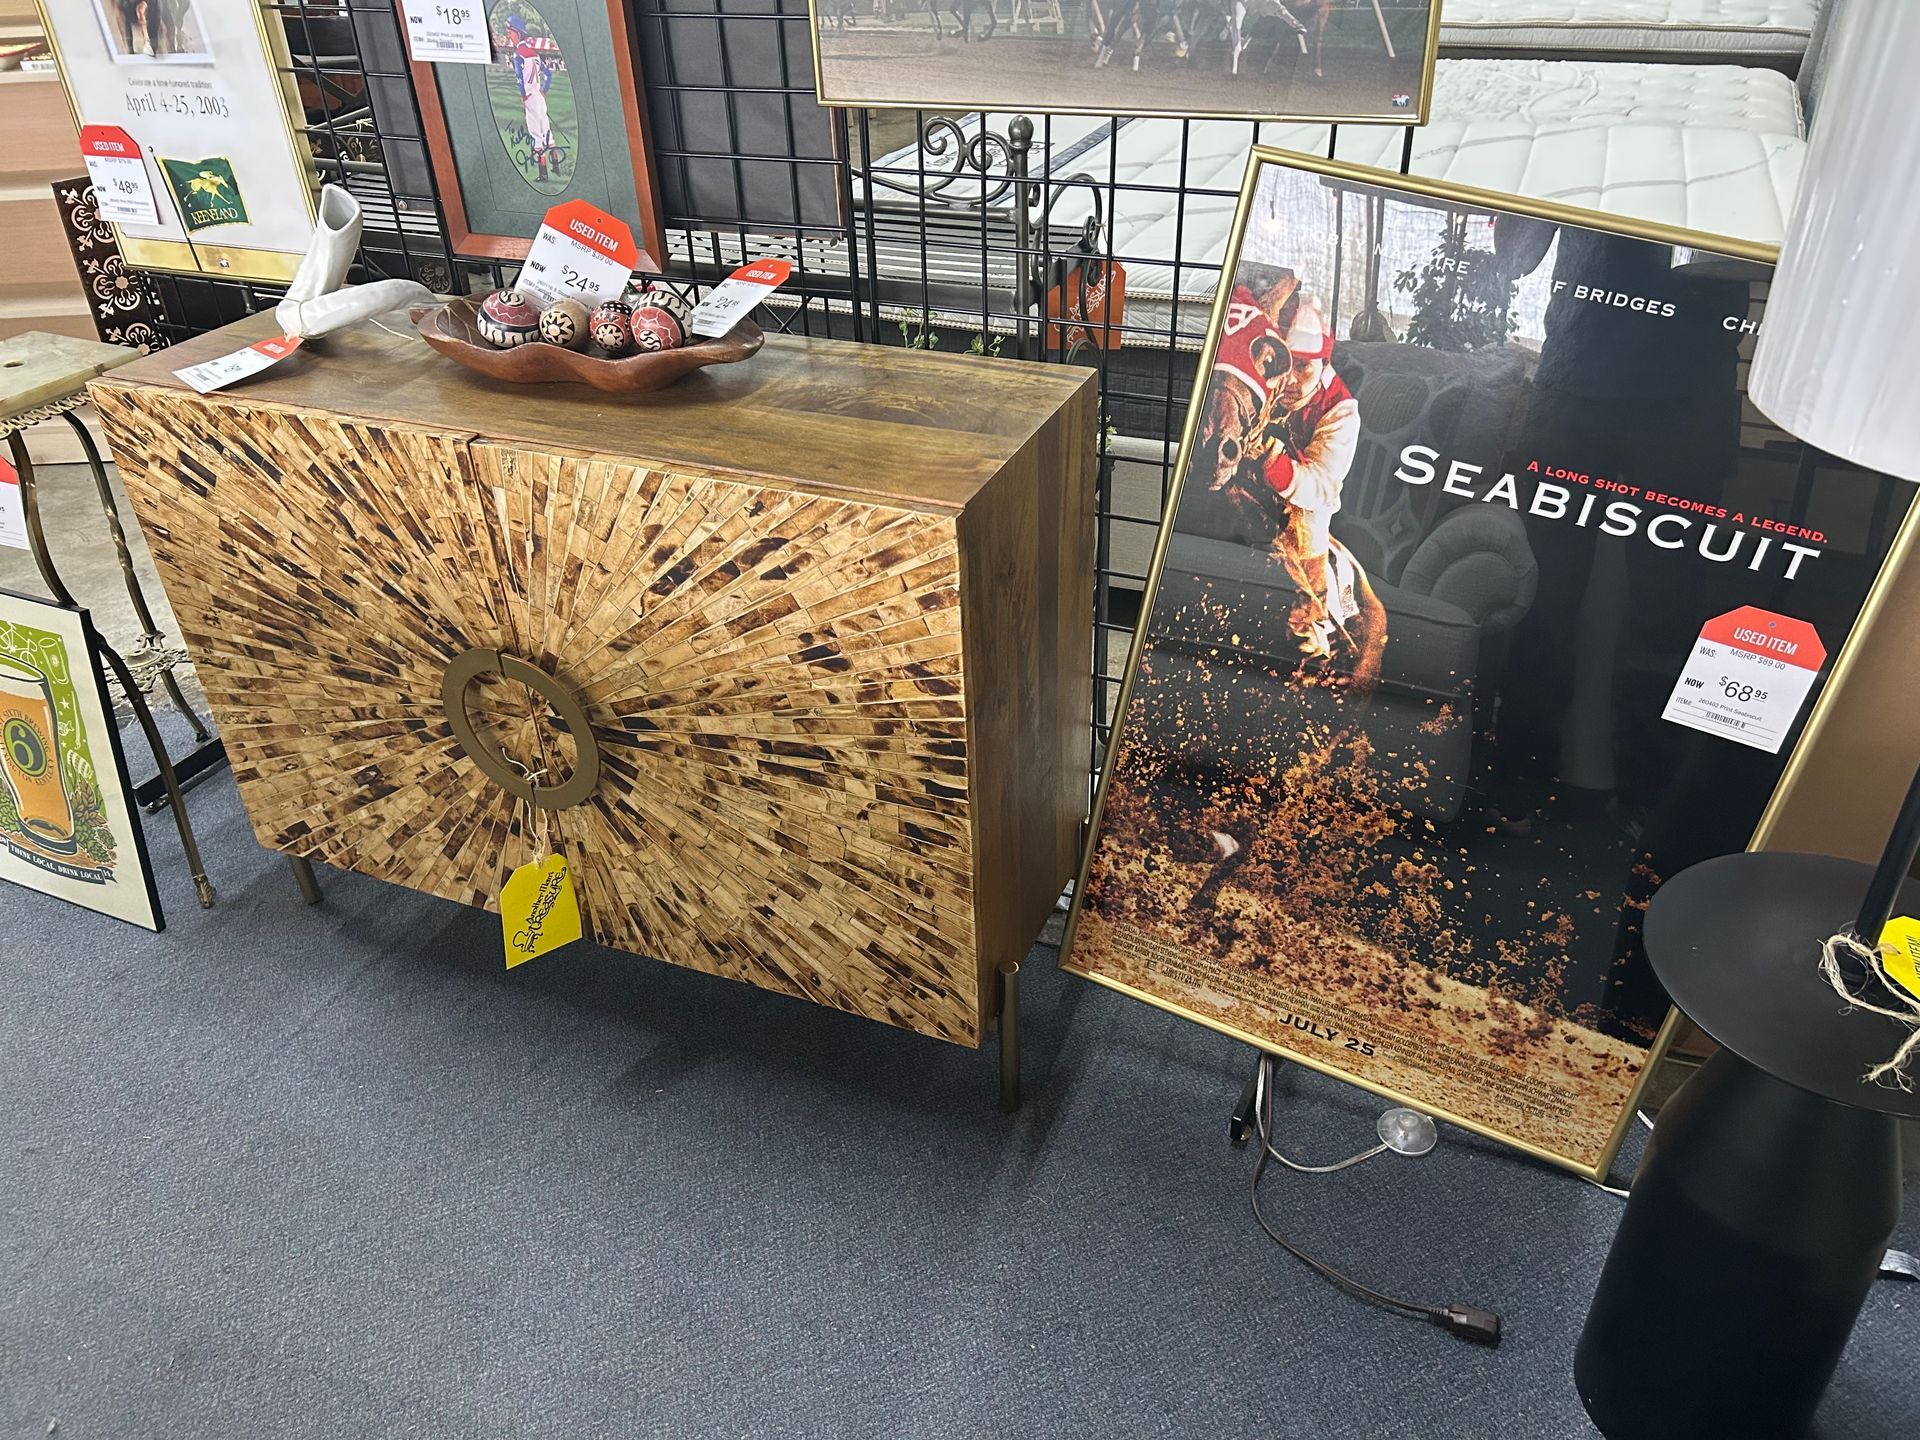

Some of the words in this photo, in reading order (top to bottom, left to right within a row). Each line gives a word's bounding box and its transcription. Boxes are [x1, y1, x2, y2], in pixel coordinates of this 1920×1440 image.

[410, 16, 423, 24] NOW
[126, 92, 157, 116] April
[196, 95, 230, 118] 2003
[92, 141, 108, 151] USED
[108, 142, 125, 152] ITEM
[190, 207, 239, 225] KEENELAND
[569, 218, 596, 241] USED
[593, 231, 619, 253] ITEM
[570, 239, 592, 254] MSRP
[530, 260, 546, 273] NOW
[1573, 284, 1677, 318] BRIDGES
[1722, 316, 1763, 336] CH
[1526, 459, 1541, 473] A
[1545, 465, 1590, 485] LONG
[1594, 477, 1640, 498] SHOT
[1644, 490, 1728, 520] BECOMES
[1731, 511, 1745, 525] A
[1751, 516, 1829, 544] LEGEND.
[1393, 444, 1821, 581] SEABISCUIT
[1733, 626, 1767, 648] USED
[1766, 636, 1799, 656] ITEM
[1729, 648, 1757, 661] MSRP
[1684, 677, 1705, 689] NOW
[10, 845, 31, 860] THINK
[57, 865, 79, 877] DRINK
[80, 871, 103, 881] LOCAL
[1278, 1011, 1339, 1043] JULY
[1344, 1035, 1376, 1057] 25
[1525, 1076, 1547, 1089] COOPER
